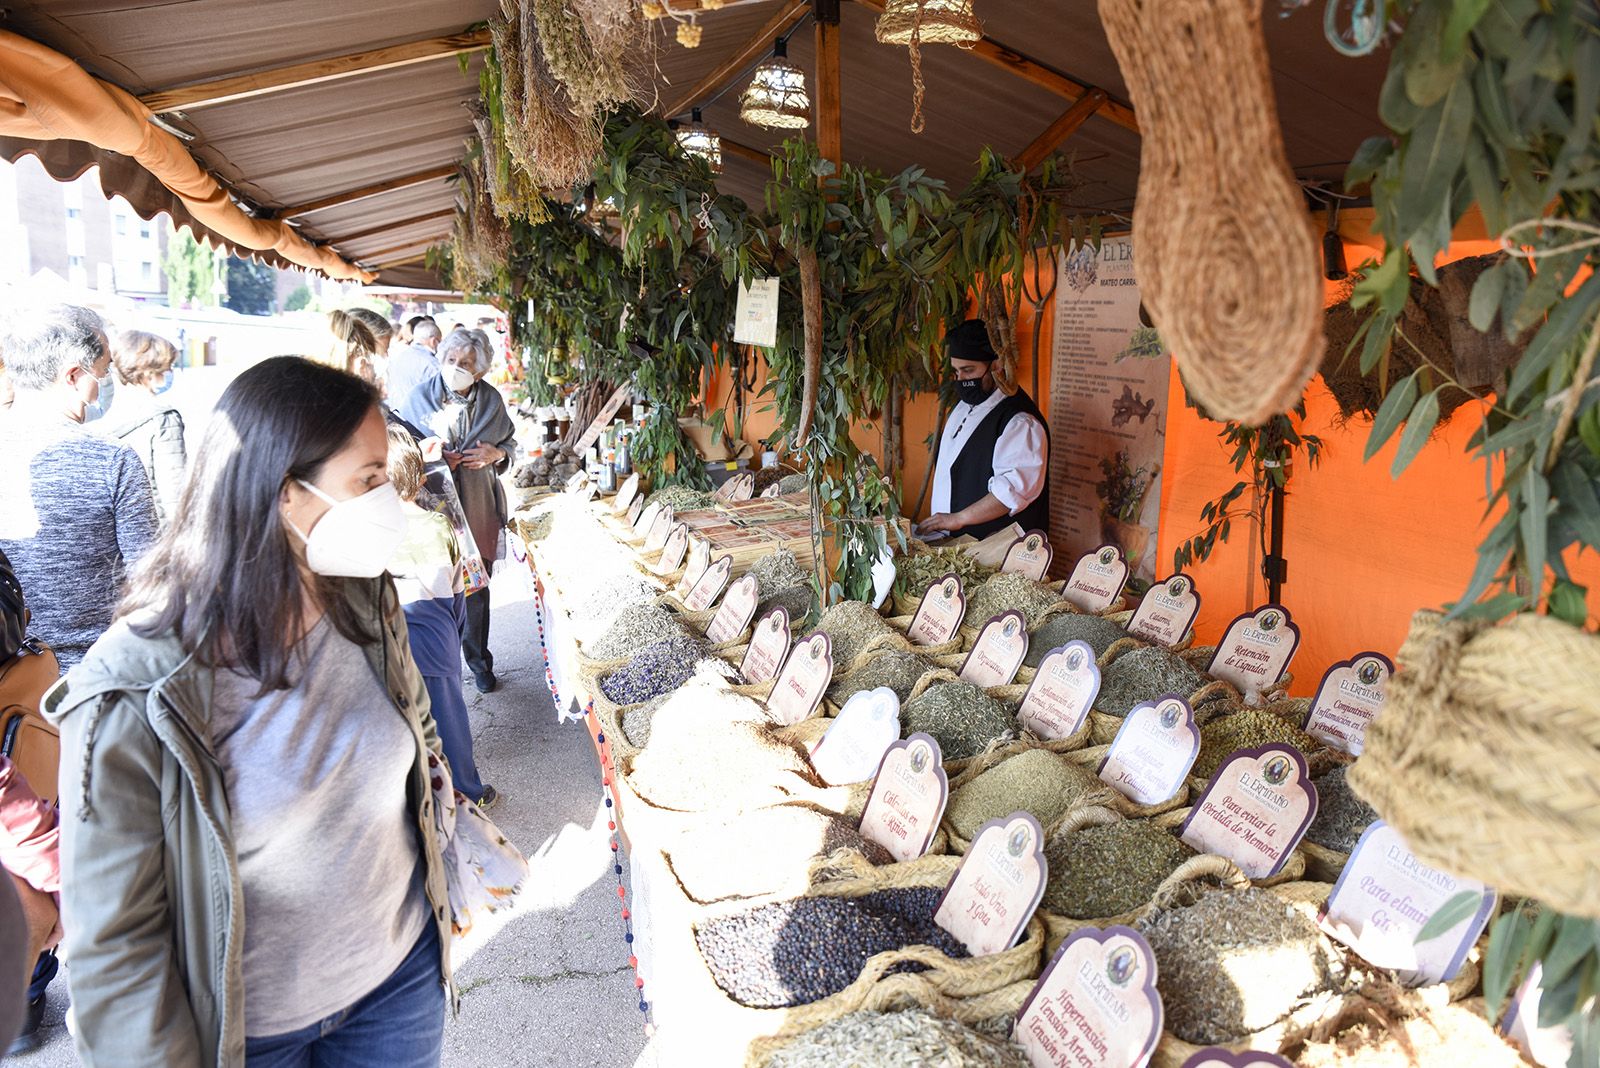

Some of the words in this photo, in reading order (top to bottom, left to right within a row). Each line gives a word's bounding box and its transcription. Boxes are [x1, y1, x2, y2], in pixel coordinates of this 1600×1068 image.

[1103, 243, 1116, 261] EL
[1118, 242, 1134, 260] ER
[1100, 279, 1118, 287] MATEO
[1119, 278, 1136, 286] CARRA
[1070, 580, 1110, 598] Antianémico
[1243, 628, 1250, 636] EL
[1252, 630, 1281, 644] ERMITAÑO
[1234, 645, 1270, 662] Retención
[1224, 655, 1234, 666] de
[1234, 658, 1268, 676] Líquidos
[1040, 684, 1068, 706] Inflamación
[1340, 680, 1350, 690] EL
[1350, 682, 1384, 702] ERMITAÑO
[1316, 706, 1352, 727] Inflamación
[1351, 721, 1360, 730] en
[1318, 722, 1349, 740] Problemas
[1116, 771, 1124, 782] y
[1240, 772, 1250, 786] EL
[1250, 778, 1289, 810] ERMITAÑO
[887, 815, 908, 840] Riñón
[908, 813, 919, 827] en
[1222, 796, 1242, 815] Para
[1240, 810, 1268, 830] evitar
[1265, 822, 1278, 838] la
[1202, 802, 1232, 828] Pérdida
[1230, 822, 1242, 834] de
[1240, 828, 1281, 861] Memoria
[1360, 875, 1391, 904] Para
[966, 900, 976, 914] y
[971, 903, 991, 926] Gota
[1080, 960, 1090, 979] EL
[1090, 973, 1130, 1024] ERMITAÑO
[1040, 996, 1069, 1040] Tensión
[1056, 988, 1108, 1062] Hipertensión,
[1030, 1015, 1058, 1059] Tensión
